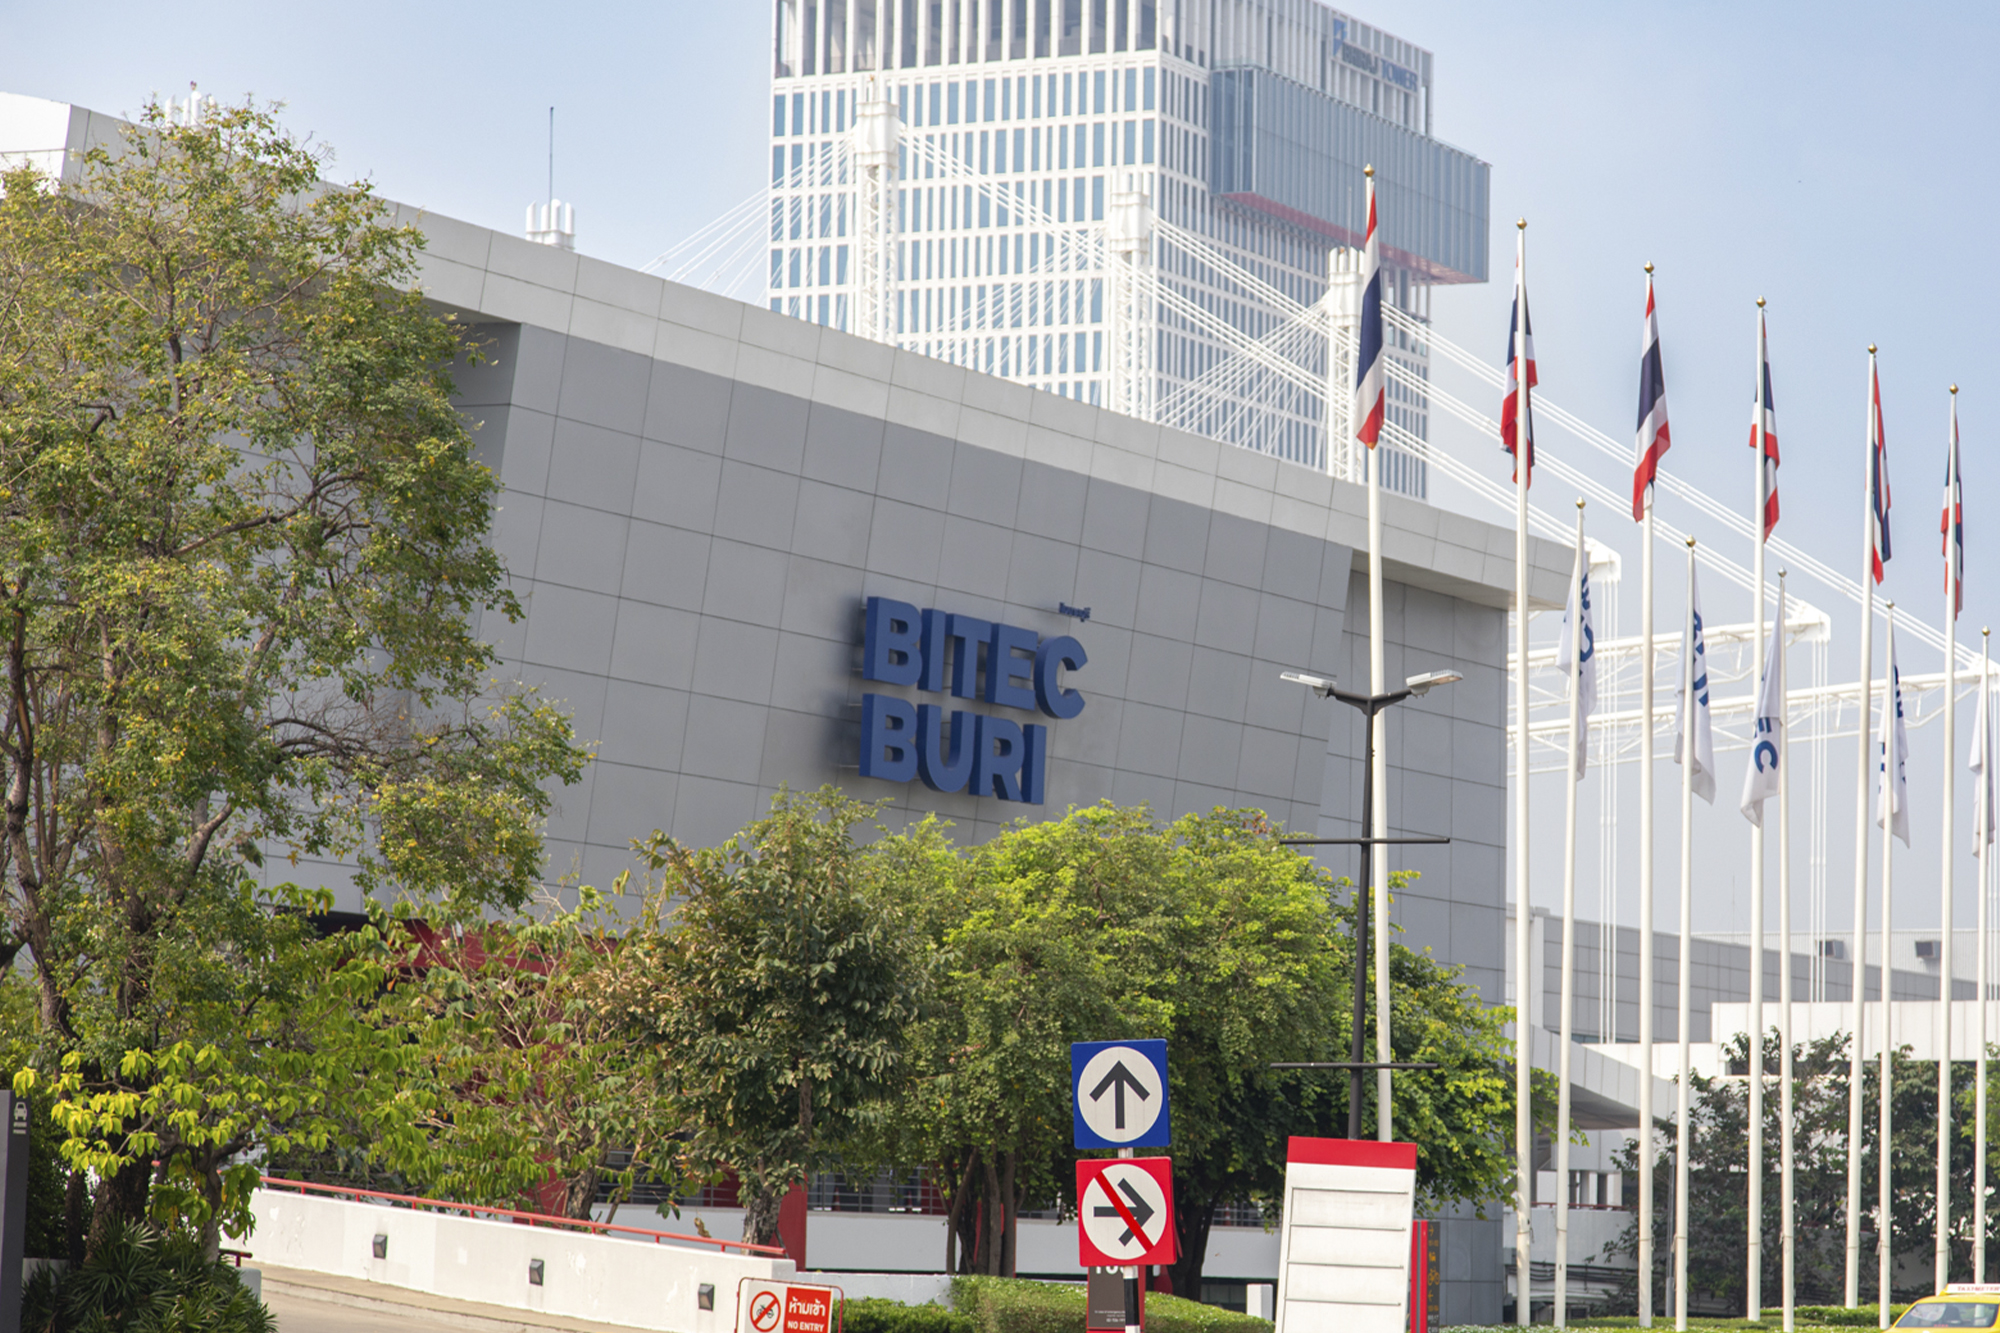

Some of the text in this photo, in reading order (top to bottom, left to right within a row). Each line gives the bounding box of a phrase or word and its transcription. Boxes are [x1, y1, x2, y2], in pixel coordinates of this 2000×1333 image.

[1380, 58, 1418, 93] TOWER
[863, 596, 1088, 719] BITEC
[859, 693, 1047, 805] BURI
[788, 1296, 826, 1317] ห้ามเข้า
[787, 1320, 824, 1332] NO ENTRY
